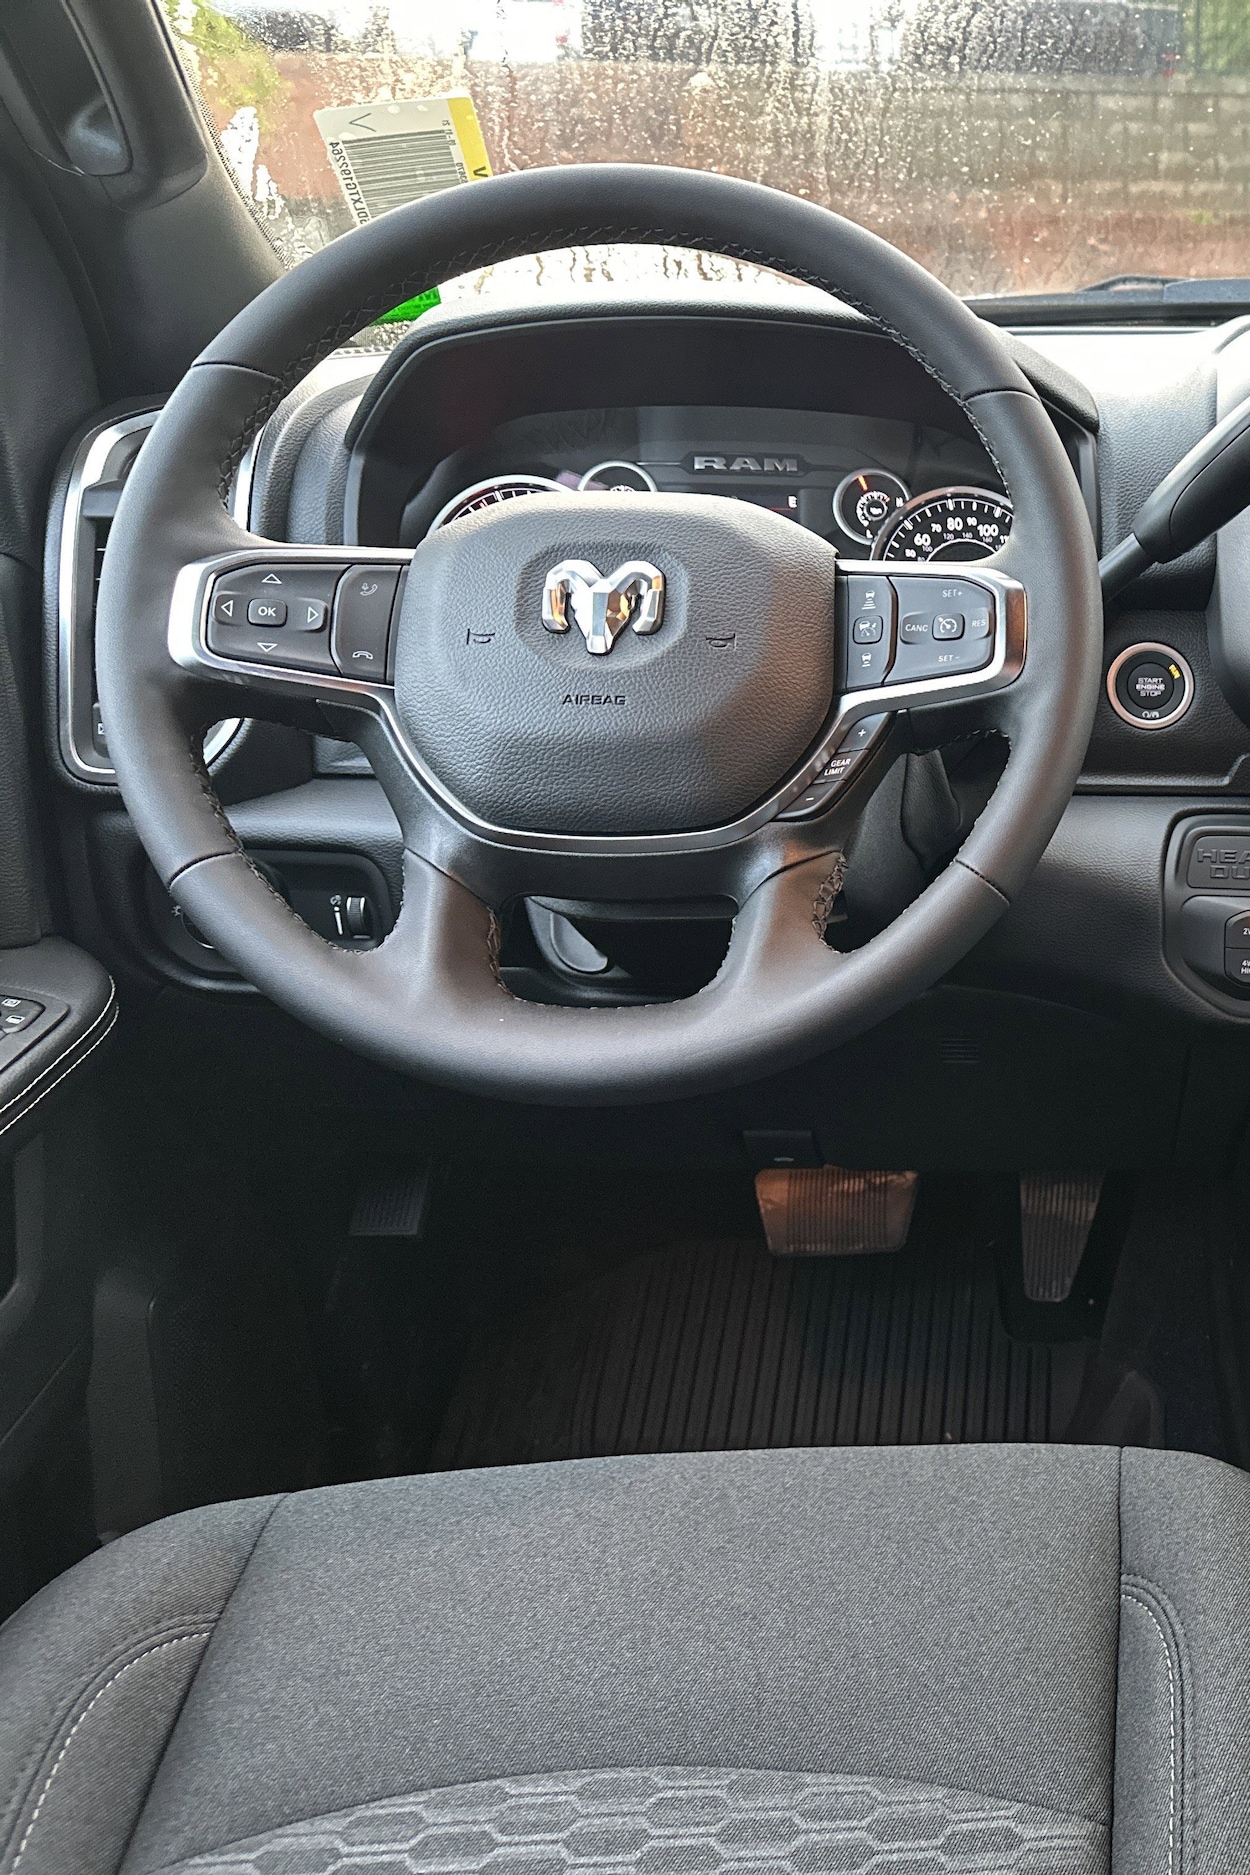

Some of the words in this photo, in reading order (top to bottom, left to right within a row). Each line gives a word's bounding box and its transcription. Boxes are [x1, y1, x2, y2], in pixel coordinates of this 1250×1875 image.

[693, 456, 799, 473] RAM
[931, 523, 942, 533] 70
[946, 517, 963, 531] 80
[977, 524, 999, 537] 100
[914, 533, 931, 547] 60
[257, 606, 277, 617] OK
[905, 623, 929, 632] CANC
[971, 619, 986, 627] RES
[562, 694, 627, 705] AIRBAG
[830, 758, 851, 767] GEAR
[824, 767, 845, 776] LIMIT
